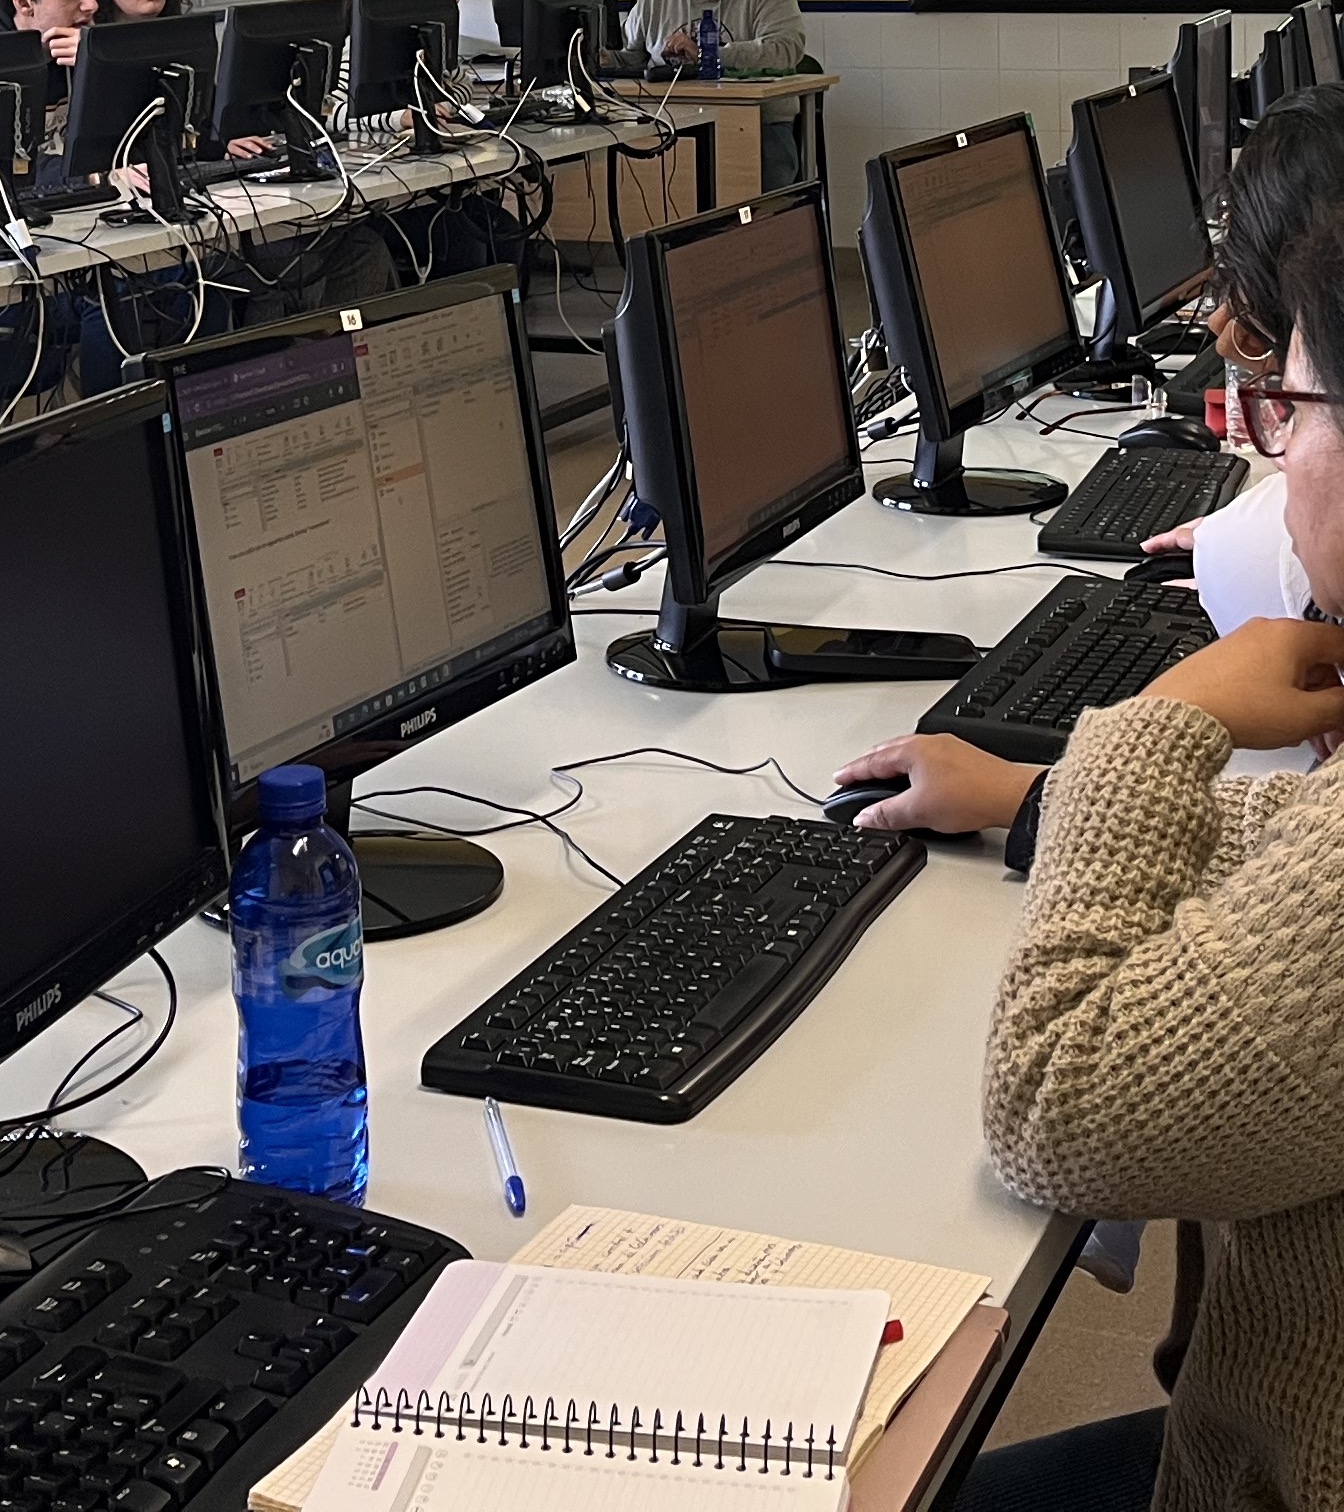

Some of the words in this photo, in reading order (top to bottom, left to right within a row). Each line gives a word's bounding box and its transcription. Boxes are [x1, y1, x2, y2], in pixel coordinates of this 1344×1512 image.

[346, 314, 357, 326] 16
[400, 706, 437, 739] PHILIPS
[16, 983, 62, 1033] PHILIPS
